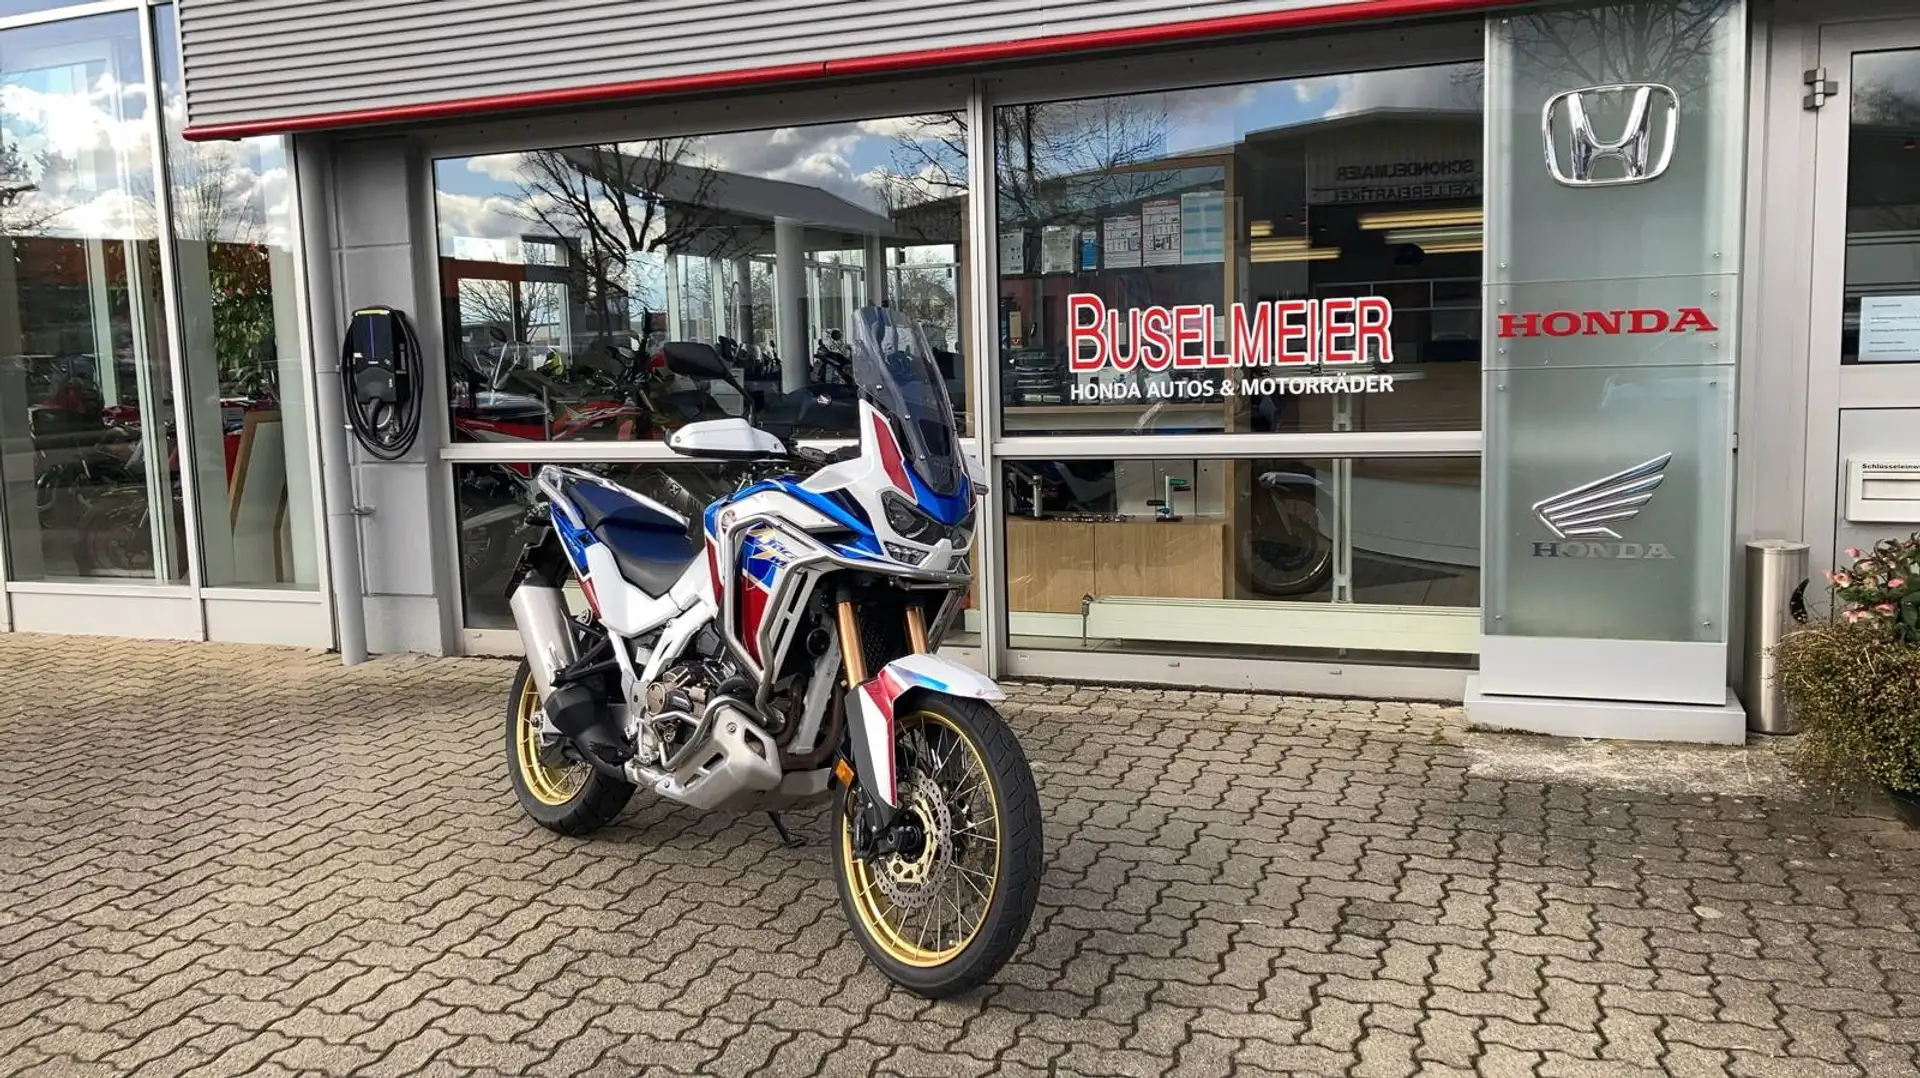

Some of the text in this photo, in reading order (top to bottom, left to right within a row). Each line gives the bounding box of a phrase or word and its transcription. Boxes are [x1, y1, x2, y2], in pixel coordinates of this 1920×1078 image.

[1068, 294, 1394, 373] BUSELMEIER
[1498, 308, 1719, 338] HONDA
[1070, 372, 1394, 400] HONDA AUTOS & MOTORRÄDER
[1532, 541, 1676, 559] HONDA
